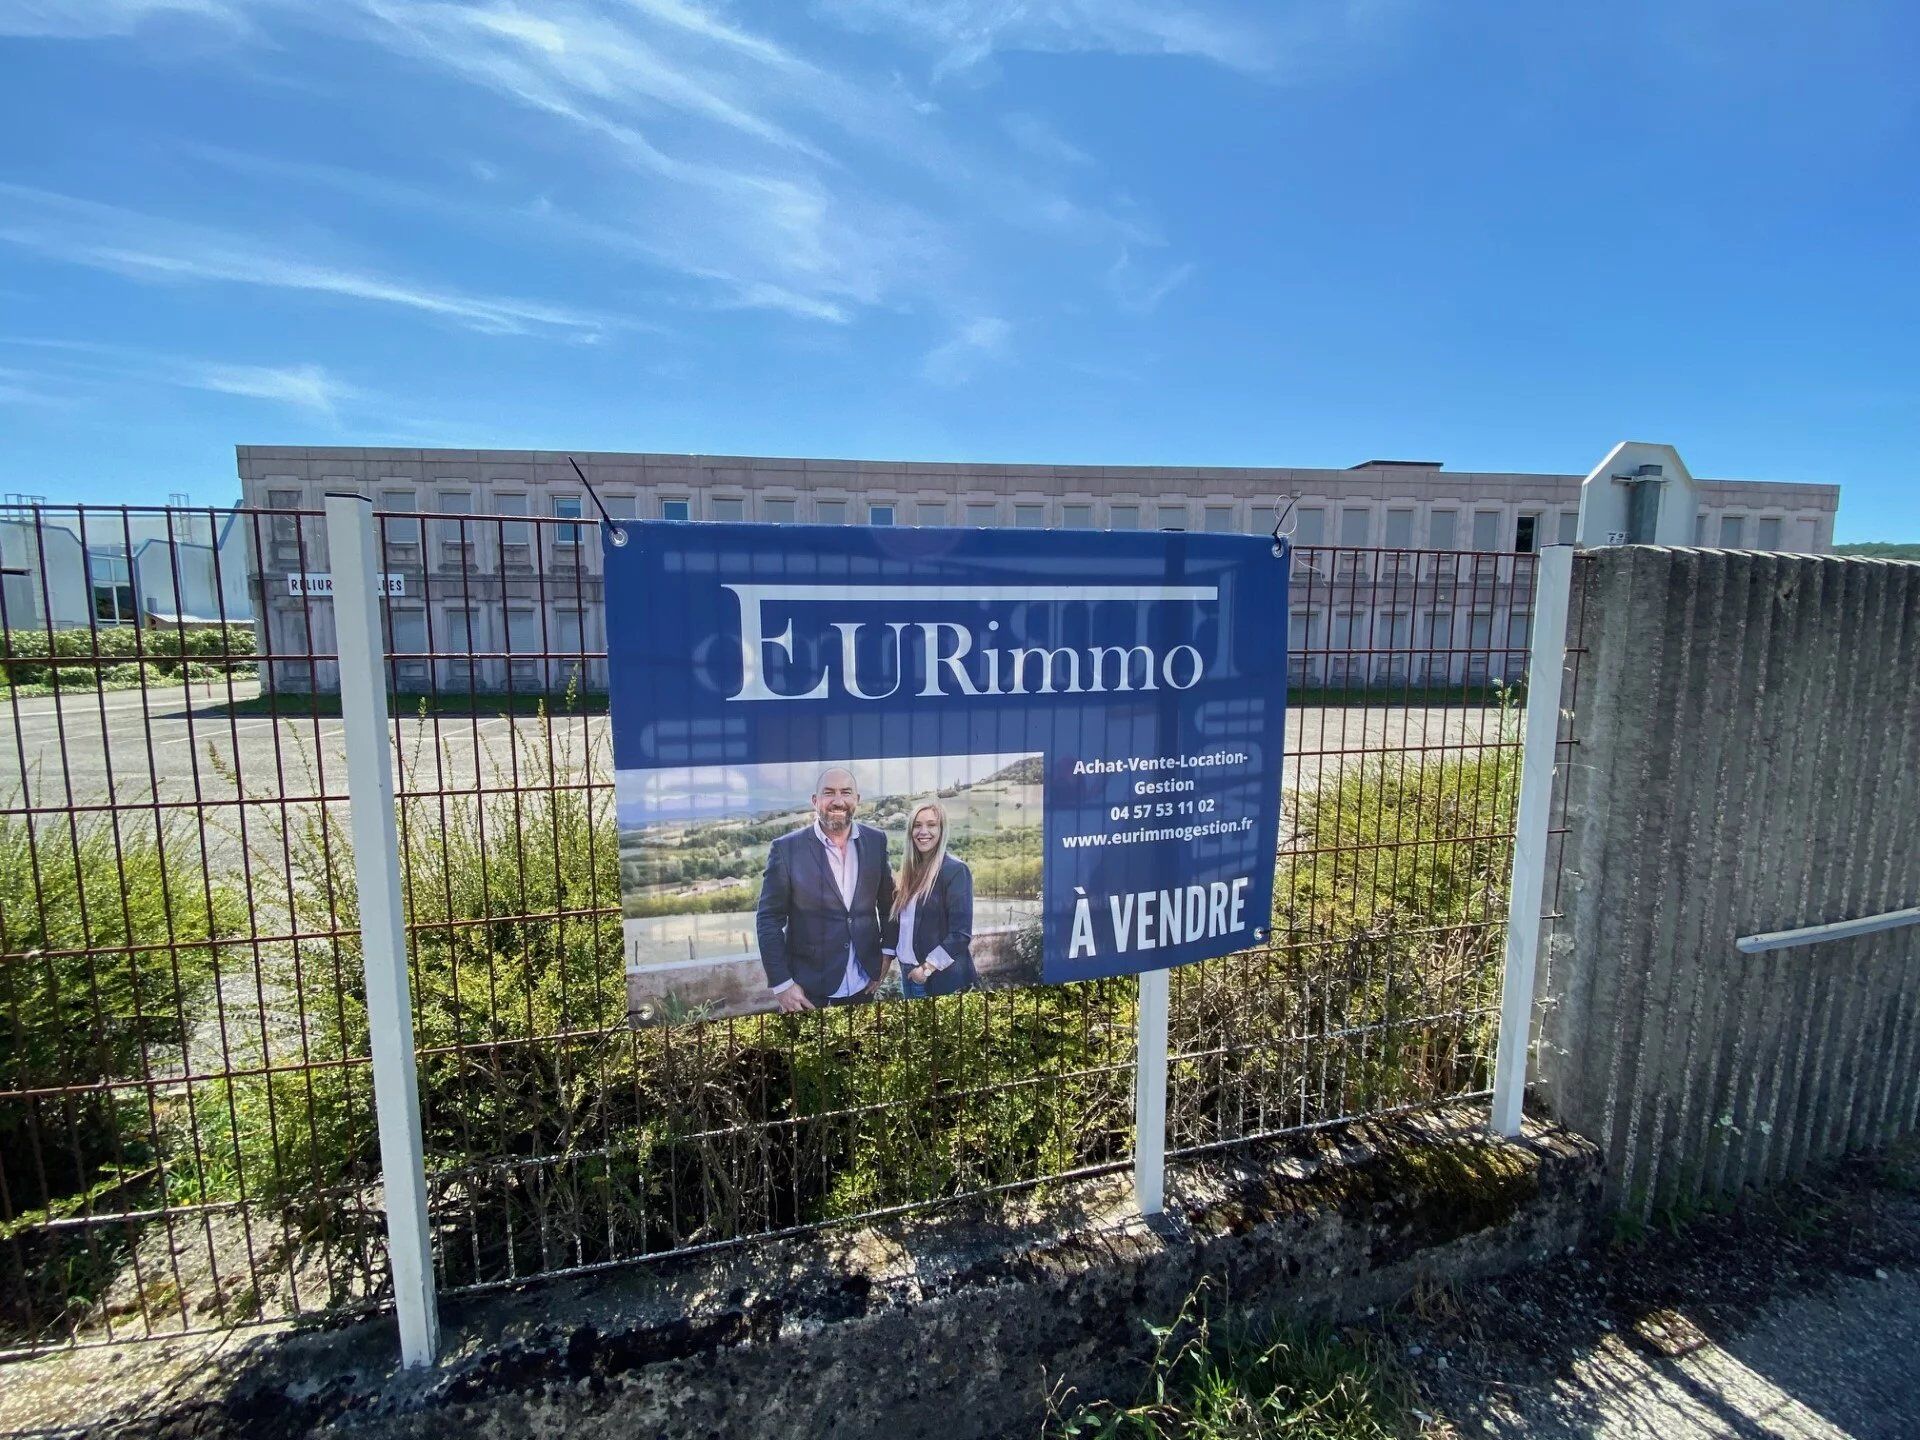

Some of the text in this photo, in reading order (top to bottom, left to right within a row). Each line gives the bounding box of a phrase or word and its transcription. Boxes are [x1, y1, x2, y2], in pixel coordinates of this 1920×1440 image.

[721, 584, 1218, 702] EURimmo
[1072, 751, 1248, 775] Achat-Vente-Location-
[1134, 778, 1195, 795] Gestion
[1110, 799, 1215, 821] 04 57 53 11 02
[1062, 817, 1253, 848] www.eurimmogestion.fr
[1068, 876, 1249, 959] À VENDRE
